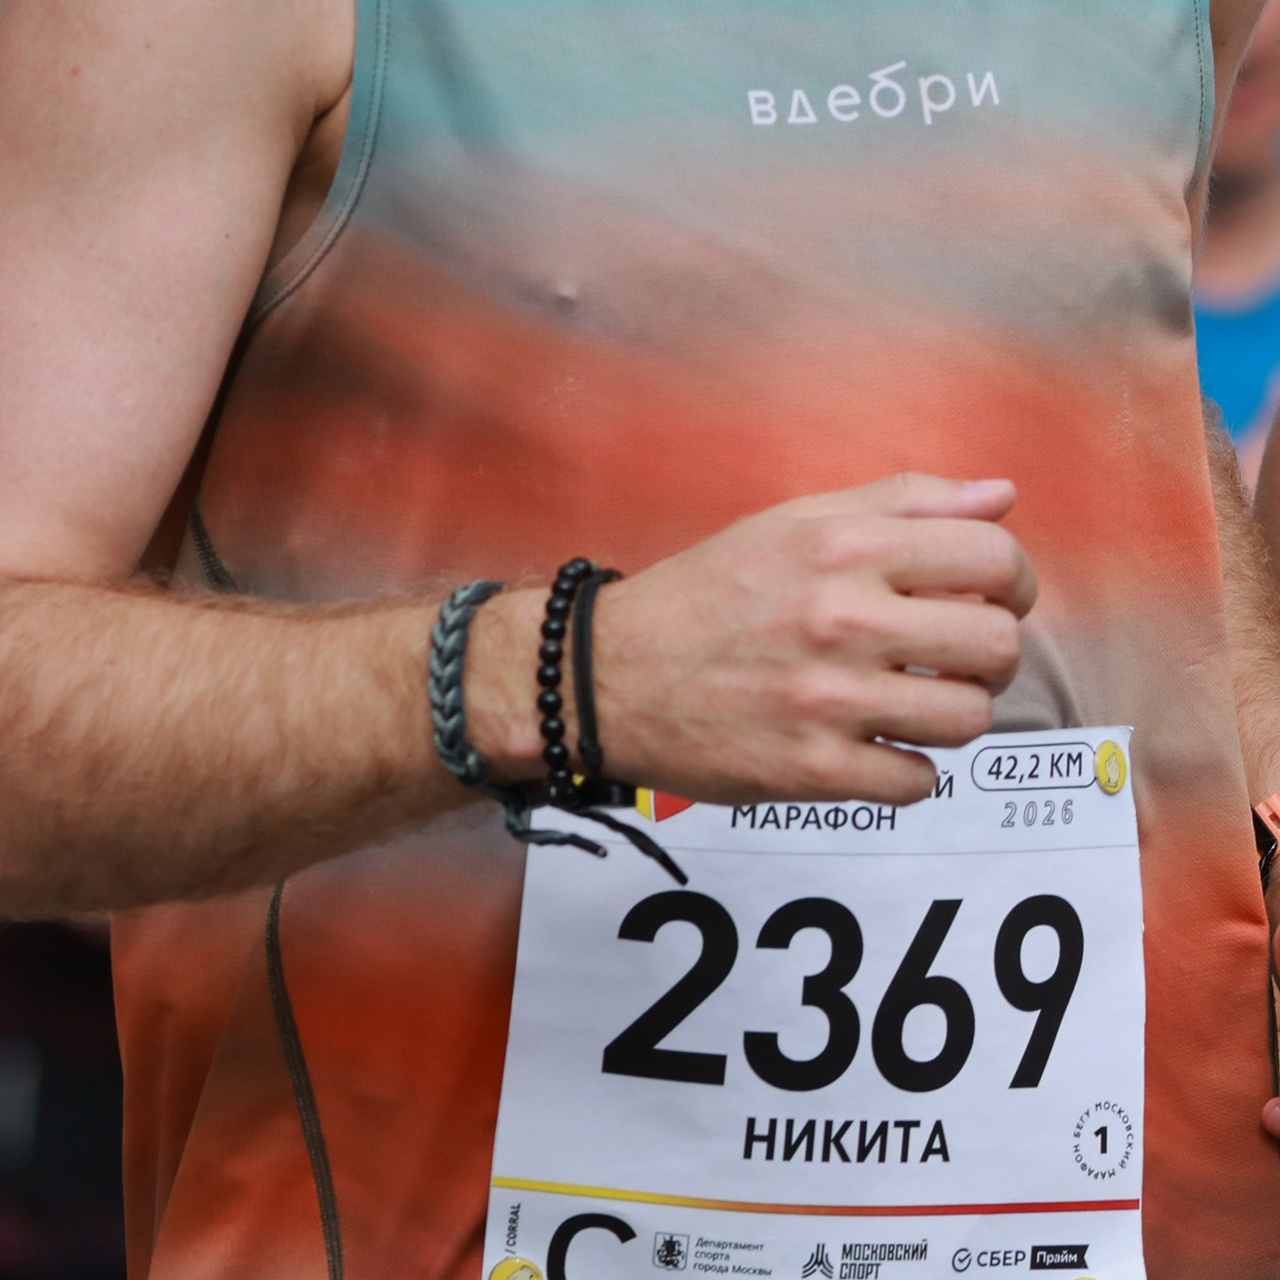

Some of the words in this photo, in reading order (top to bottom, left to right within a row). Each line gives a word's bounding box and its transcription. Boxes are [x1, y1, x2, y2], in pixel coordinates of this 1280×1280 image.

[748, 60, 1000, 125] вдебри
[986, 753, 1041, 783] 42,2
[1049, 751, 1083, 779] КМ
[730, 802, 897, 831] МАРАФОН
[1001, 800, 1074, 827] 2026
[601, 890, 1085, 1093] 2369
[1073, 1108, 1090, 1138] БЕГУ
[743, 1117, 950, 1164] НИКИТА
[1093, 1125, 1108, 1154] 1
[1072, 1144, 1116, 1179] МАРАФОН
[507, 1203, 521, 1247] CORRAL
[694, 1251, 731, 1261] спорта
[695, 1237, 765, 1251] Департамент
[841, 1239, 928, 1261] МОСКОВСКИЙ
[977, 1250, 1026, 1267] СБЕР
[1036, 1250, 1078, 1264] Прайм
[693, 1262, 729, 1274] города
[731, 1265, 772, 1275] Москвы
[839, 1262, 882, 1280] СПОРТ
